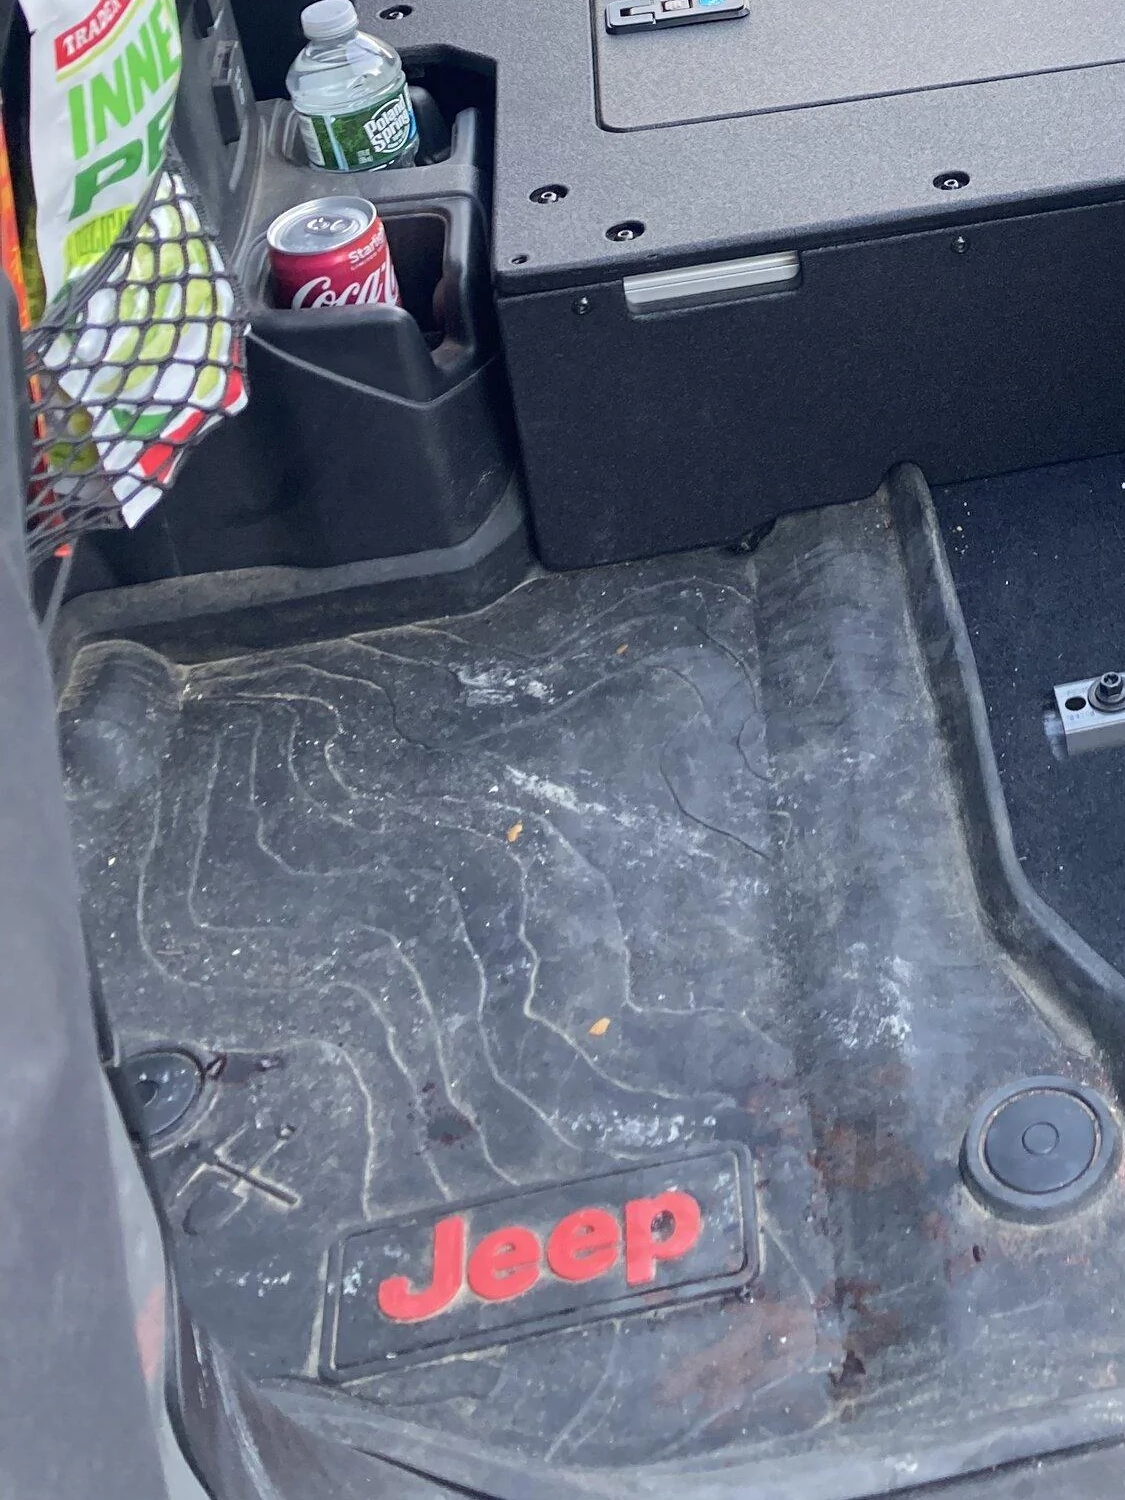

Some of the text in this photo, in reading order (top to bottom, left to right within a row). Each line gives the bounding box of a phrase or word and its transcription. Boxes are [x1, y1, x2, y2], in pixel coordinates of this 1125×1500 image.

[363, 93, 406, 141] Poland
[370, 108, 410, 153] Spring
[378, 1191, 702, 1322] Jeep
